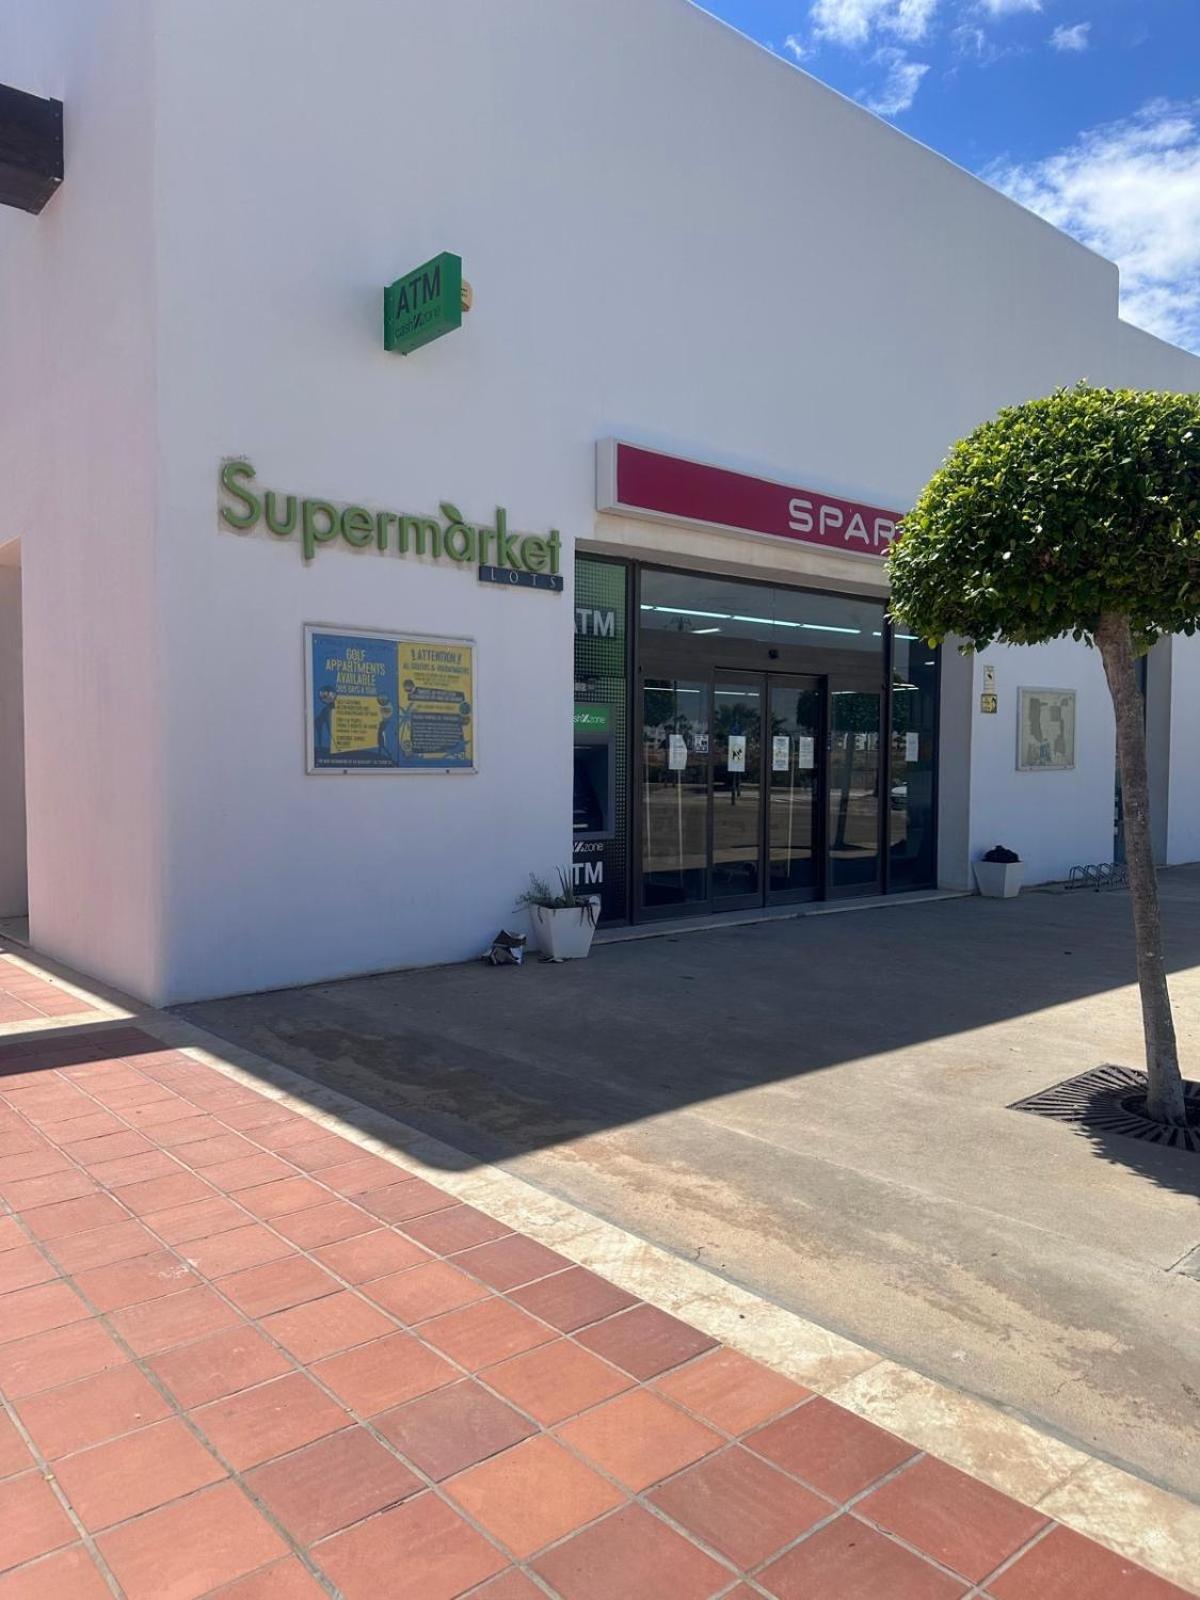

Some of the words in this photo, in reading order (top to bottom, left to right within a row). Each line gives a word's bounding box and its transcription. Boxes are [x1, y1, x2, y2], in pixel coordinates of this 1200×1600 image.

[396, 264, 441, 320] ATM
[788, 498, 896, 547] SPAR
[490, 570, 557, 588] LOTS
[574, 607, 616, 638] TM
